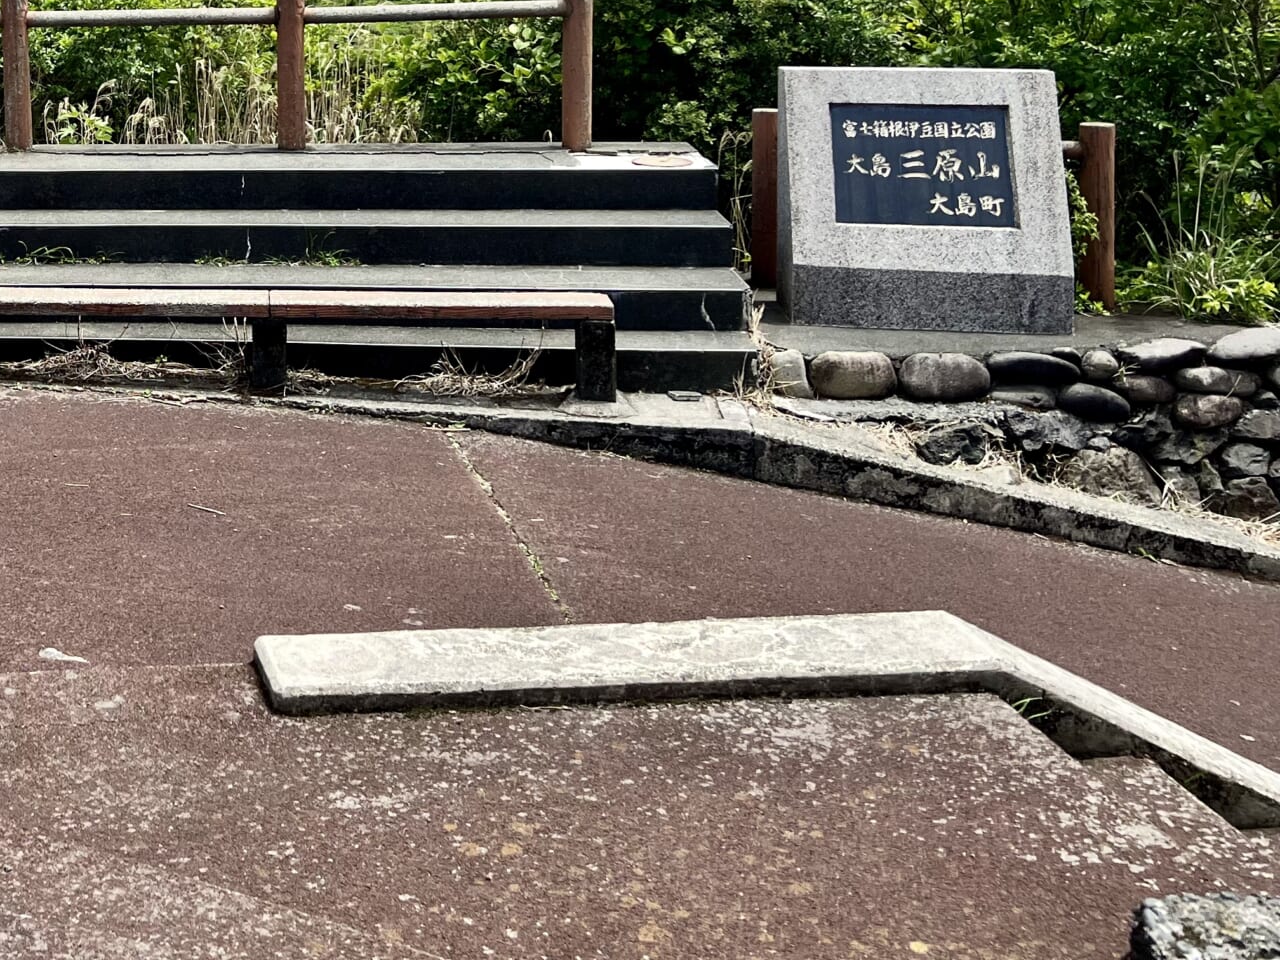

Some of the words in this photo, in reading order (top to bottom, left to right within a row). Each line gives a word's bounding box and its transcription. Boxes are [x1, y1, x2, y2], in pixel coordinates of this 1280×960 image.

[842, 119, 996, 139] 富士箱根伊豆国立公園
[927, 192, 1005, 217] 大島町
